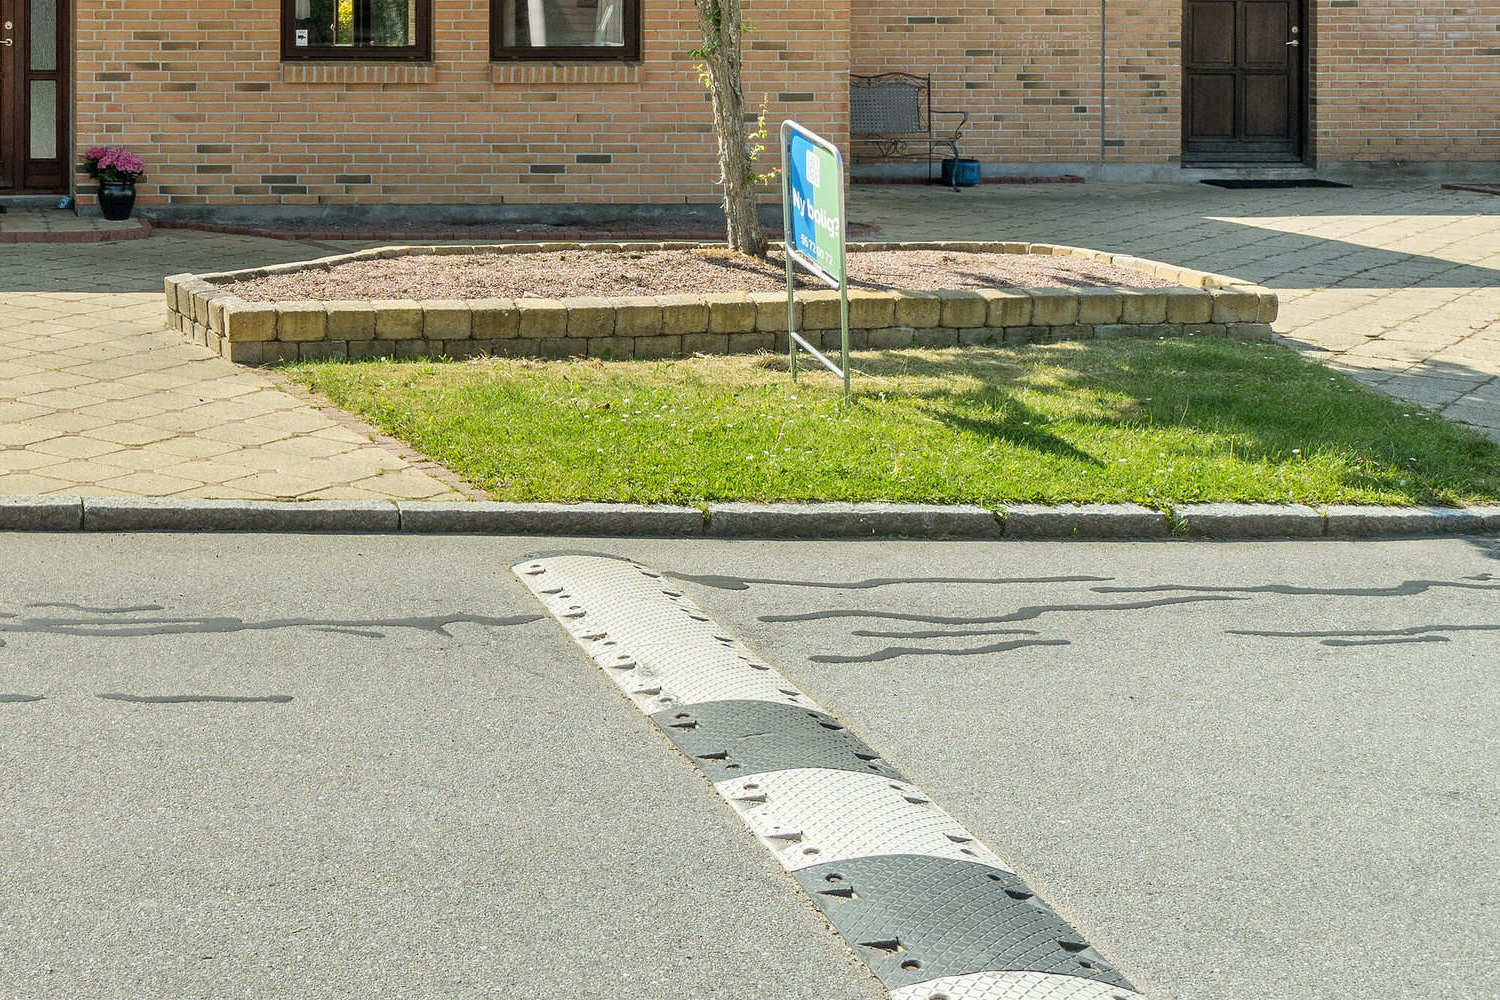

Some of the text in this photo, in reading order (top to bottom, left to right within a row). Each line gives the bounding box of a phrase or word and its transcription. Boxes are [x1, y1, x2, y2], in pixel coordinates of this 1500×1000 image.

[793, 187, 839, 237] Ny bolig?
[801, 233, 808, 247] 55
[809, 239, 816, 254] 72
[825, 251, 833, 265] 72
